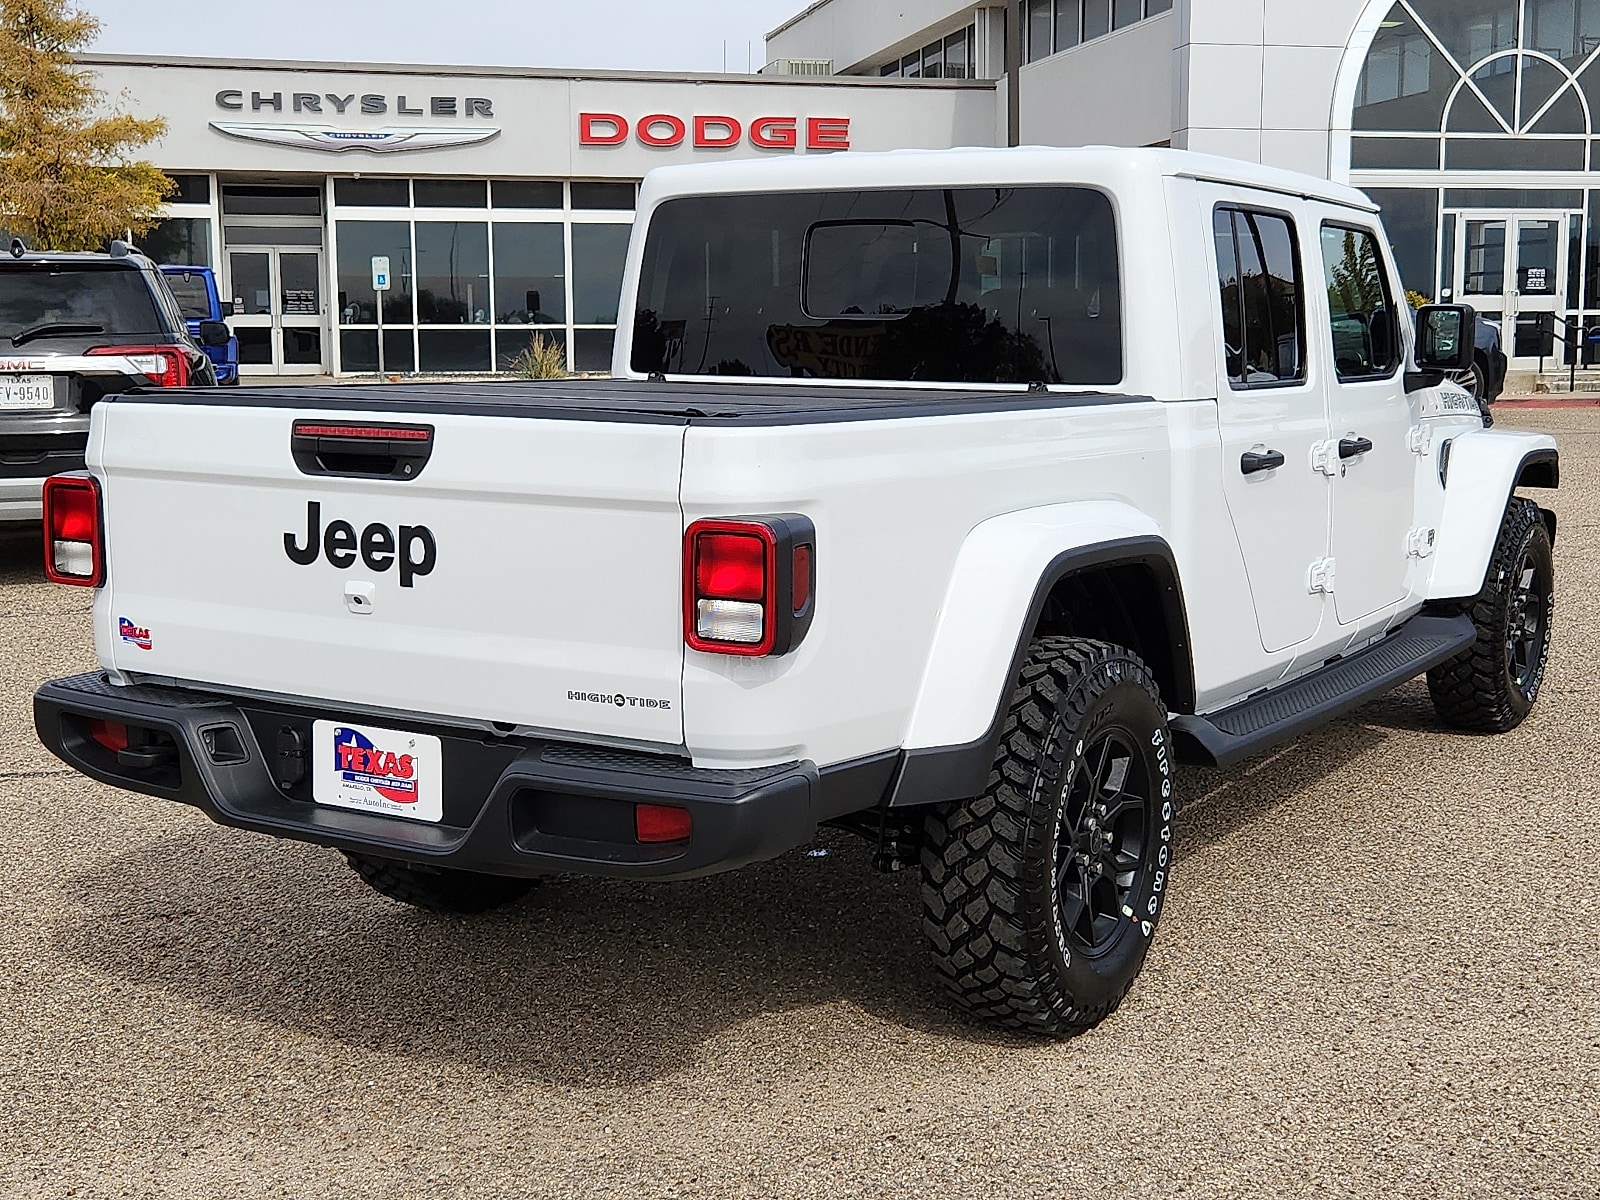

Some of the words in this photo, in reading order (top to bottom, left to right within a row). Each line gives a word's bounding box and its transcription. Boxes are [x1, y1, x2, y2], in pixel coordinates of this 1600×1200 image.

[215, 90, 494, 117] CHRYSLER
[579, 112, 851, 149] DODGE
[283, 500, 437, 588] Jeep
[567, 690, 613, 704] HIGH
[626, 696, 671, 710] TIDE
[338, 744, 414, 779] TEXAS
